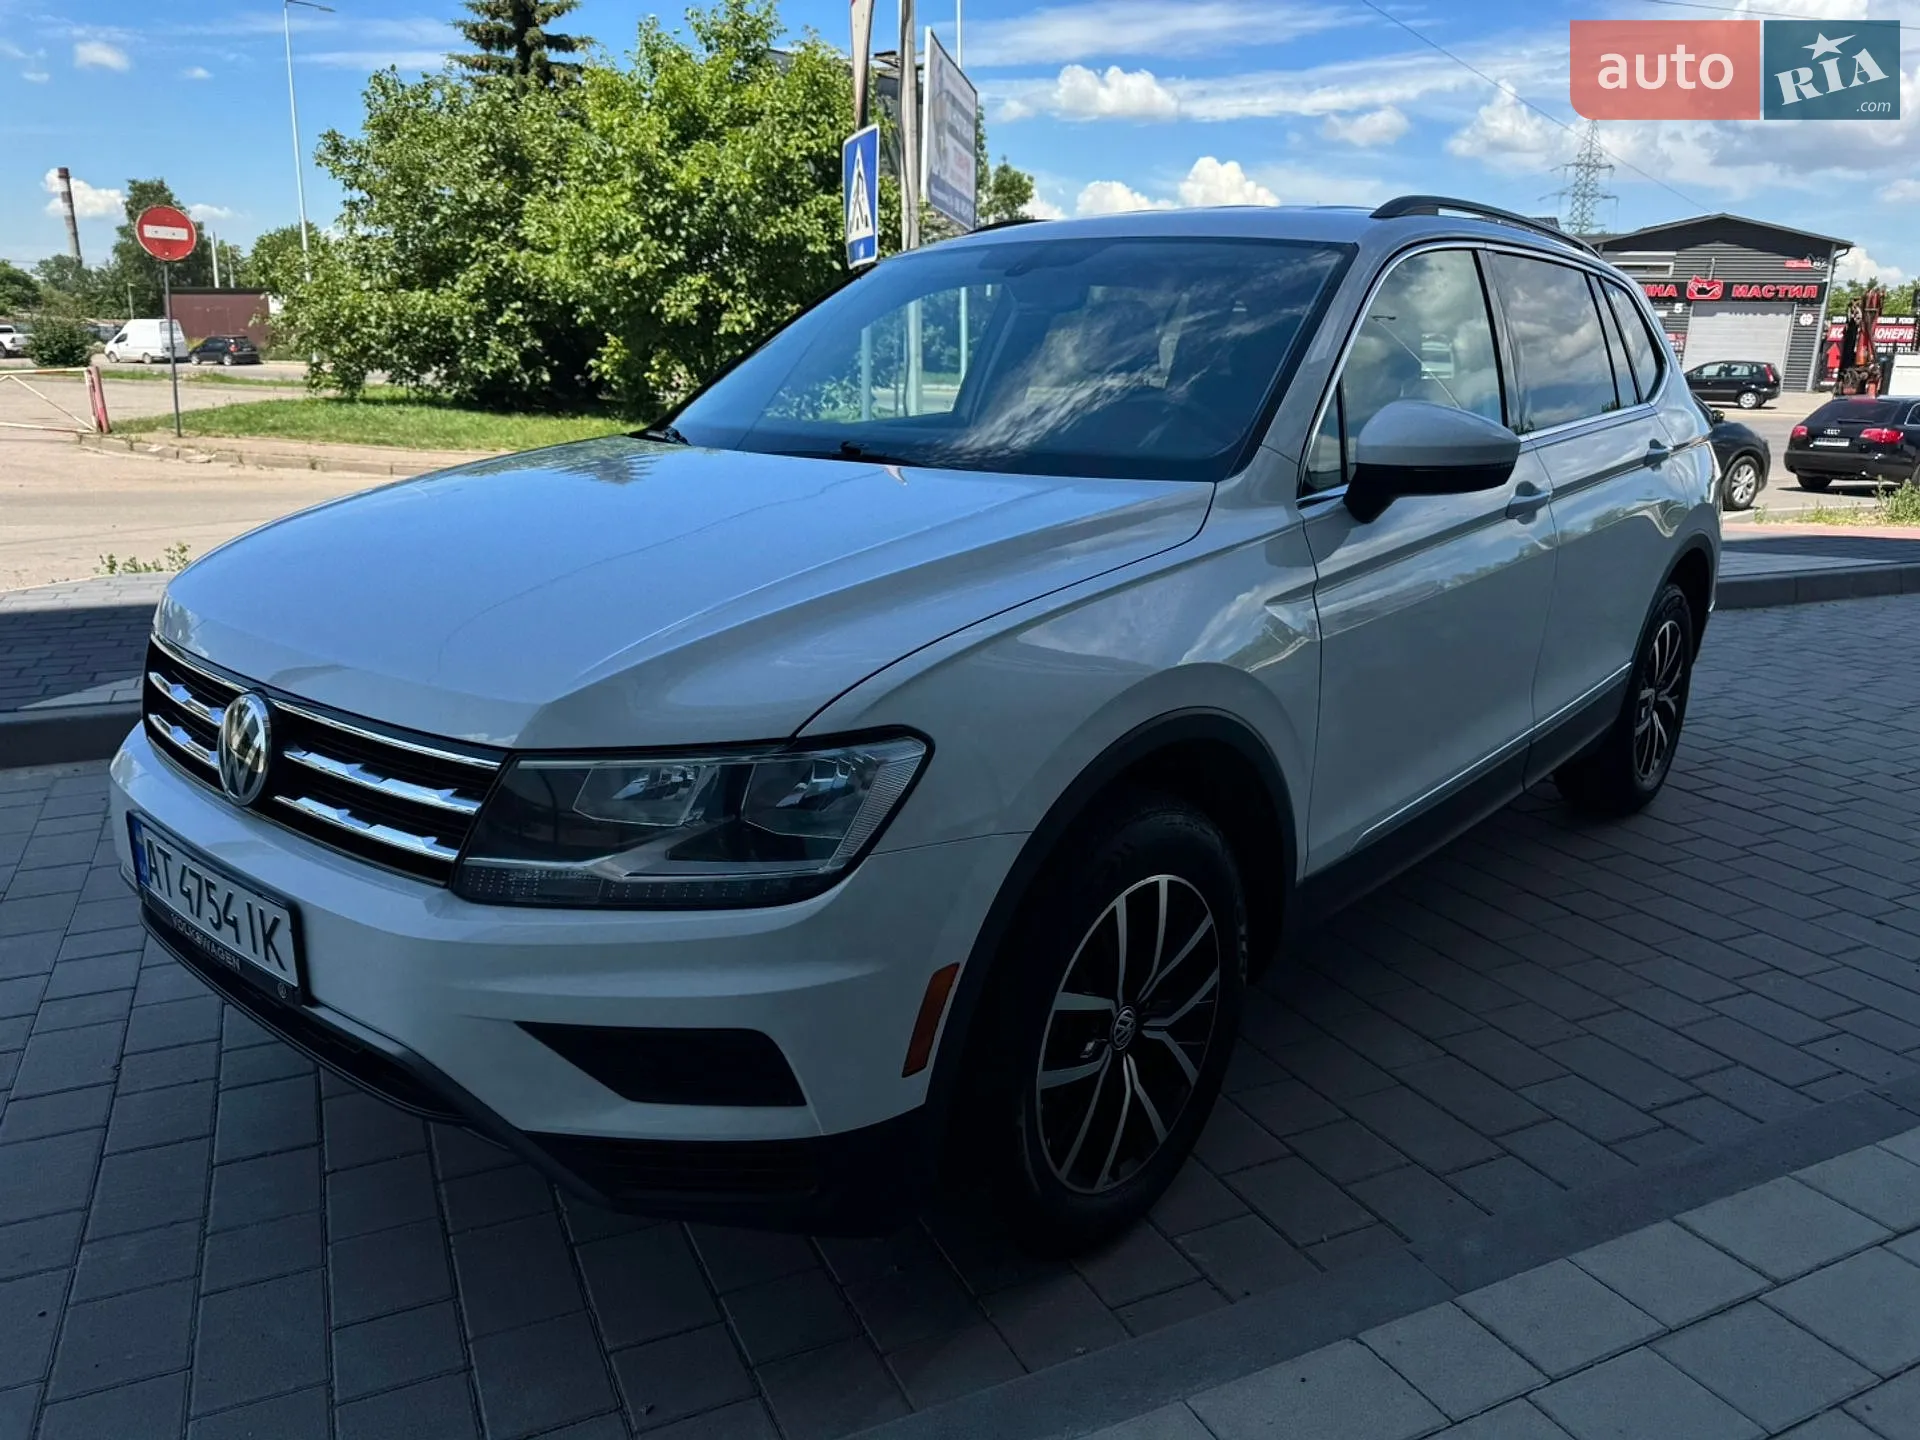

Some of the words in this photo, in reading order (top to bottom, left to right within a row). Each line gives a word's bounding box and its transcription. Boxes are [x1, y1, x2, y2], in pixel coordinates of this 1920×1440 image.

[1731, 283, 1819, 299] МАСТИЛ
[146, 836, 173, 899] AT
[178, 861, 241, 946] 4754
[246, 901, 287, 972] IK
